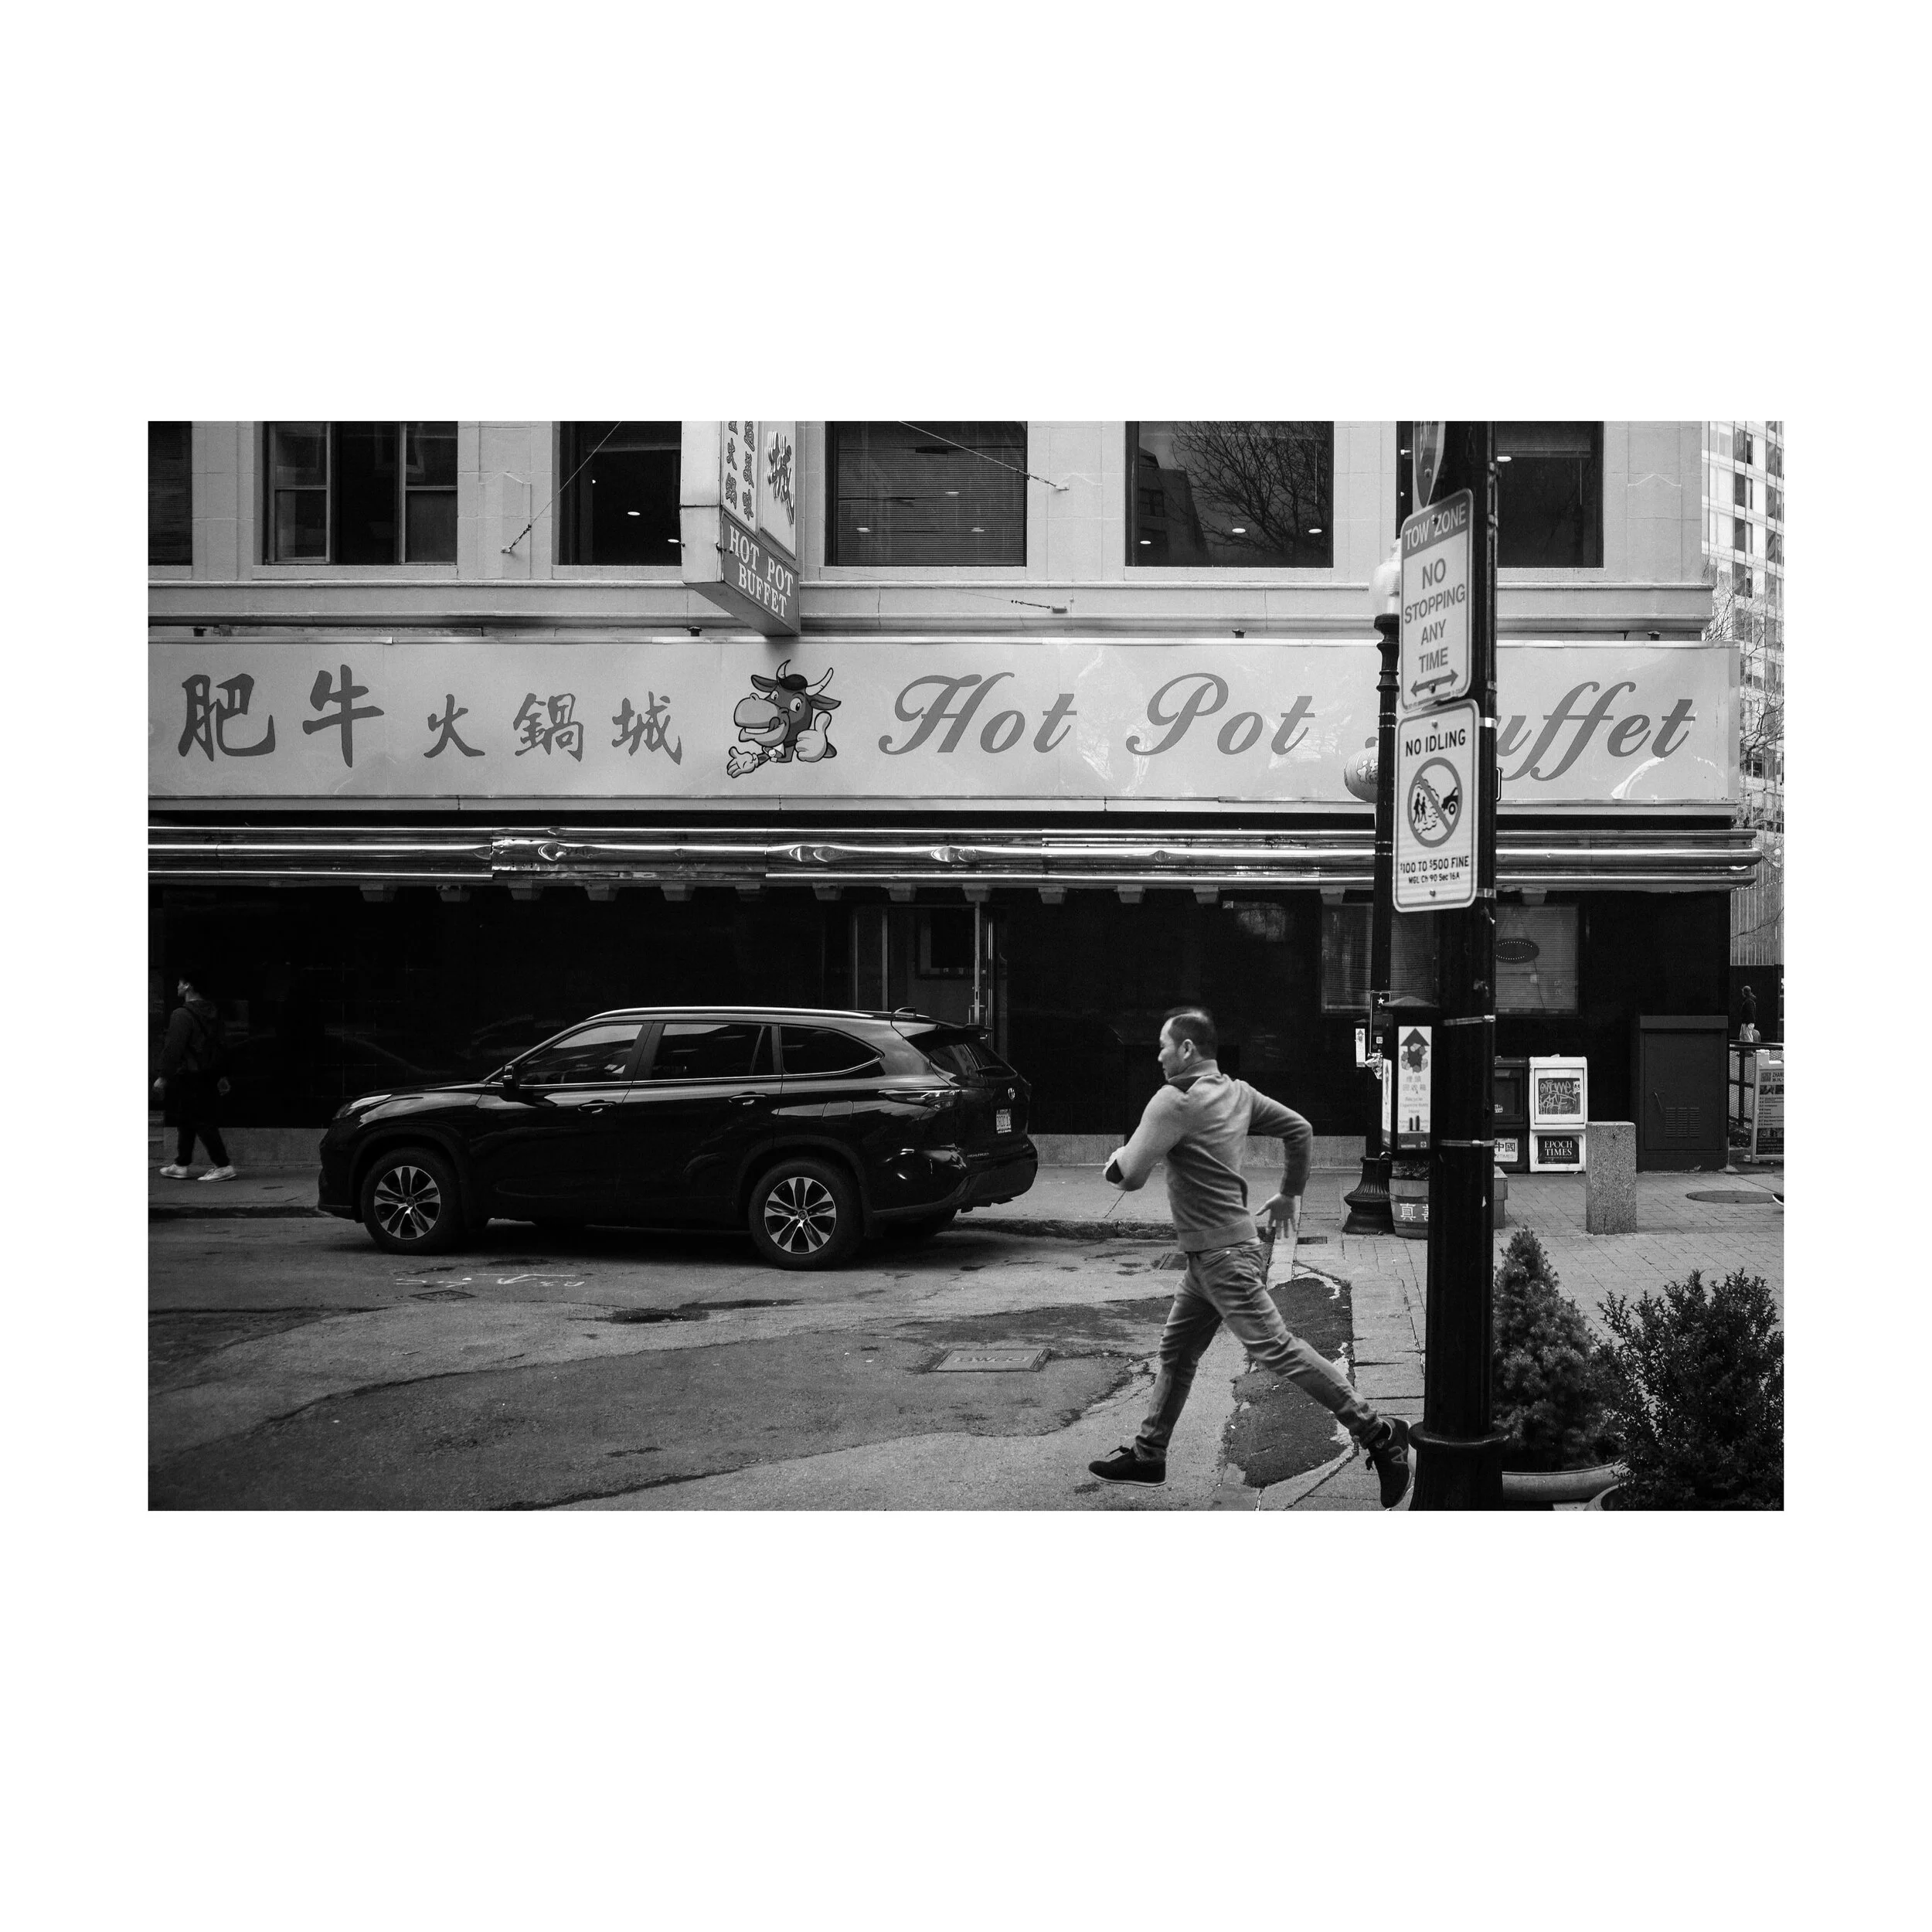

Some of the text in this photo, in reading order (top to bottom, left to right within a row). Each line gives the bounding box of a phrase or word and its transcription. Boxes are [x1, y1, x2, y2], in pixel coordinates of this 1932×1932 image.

[1405, 502, 1467, 550] TOW ZONE
[730, 525, 794, 597] HOT POT
[1422, 558, 1446, 590] NO
[738, 562, 787, 617] BUFFET
[1404, 583, 1465, 624] STOPPING
[1420, 619, 1447, 645] ANY
[1419, 647, 1448, 673] TIME
[179, 664, 682, 765] 肥牛火鍋城
[878, 672, 1696, 781] Hot Pot uffet
[1405, 729, 1466, 757] NO IDLING
[1400, 855, 1469, 874] $100 TO $500 FINE
